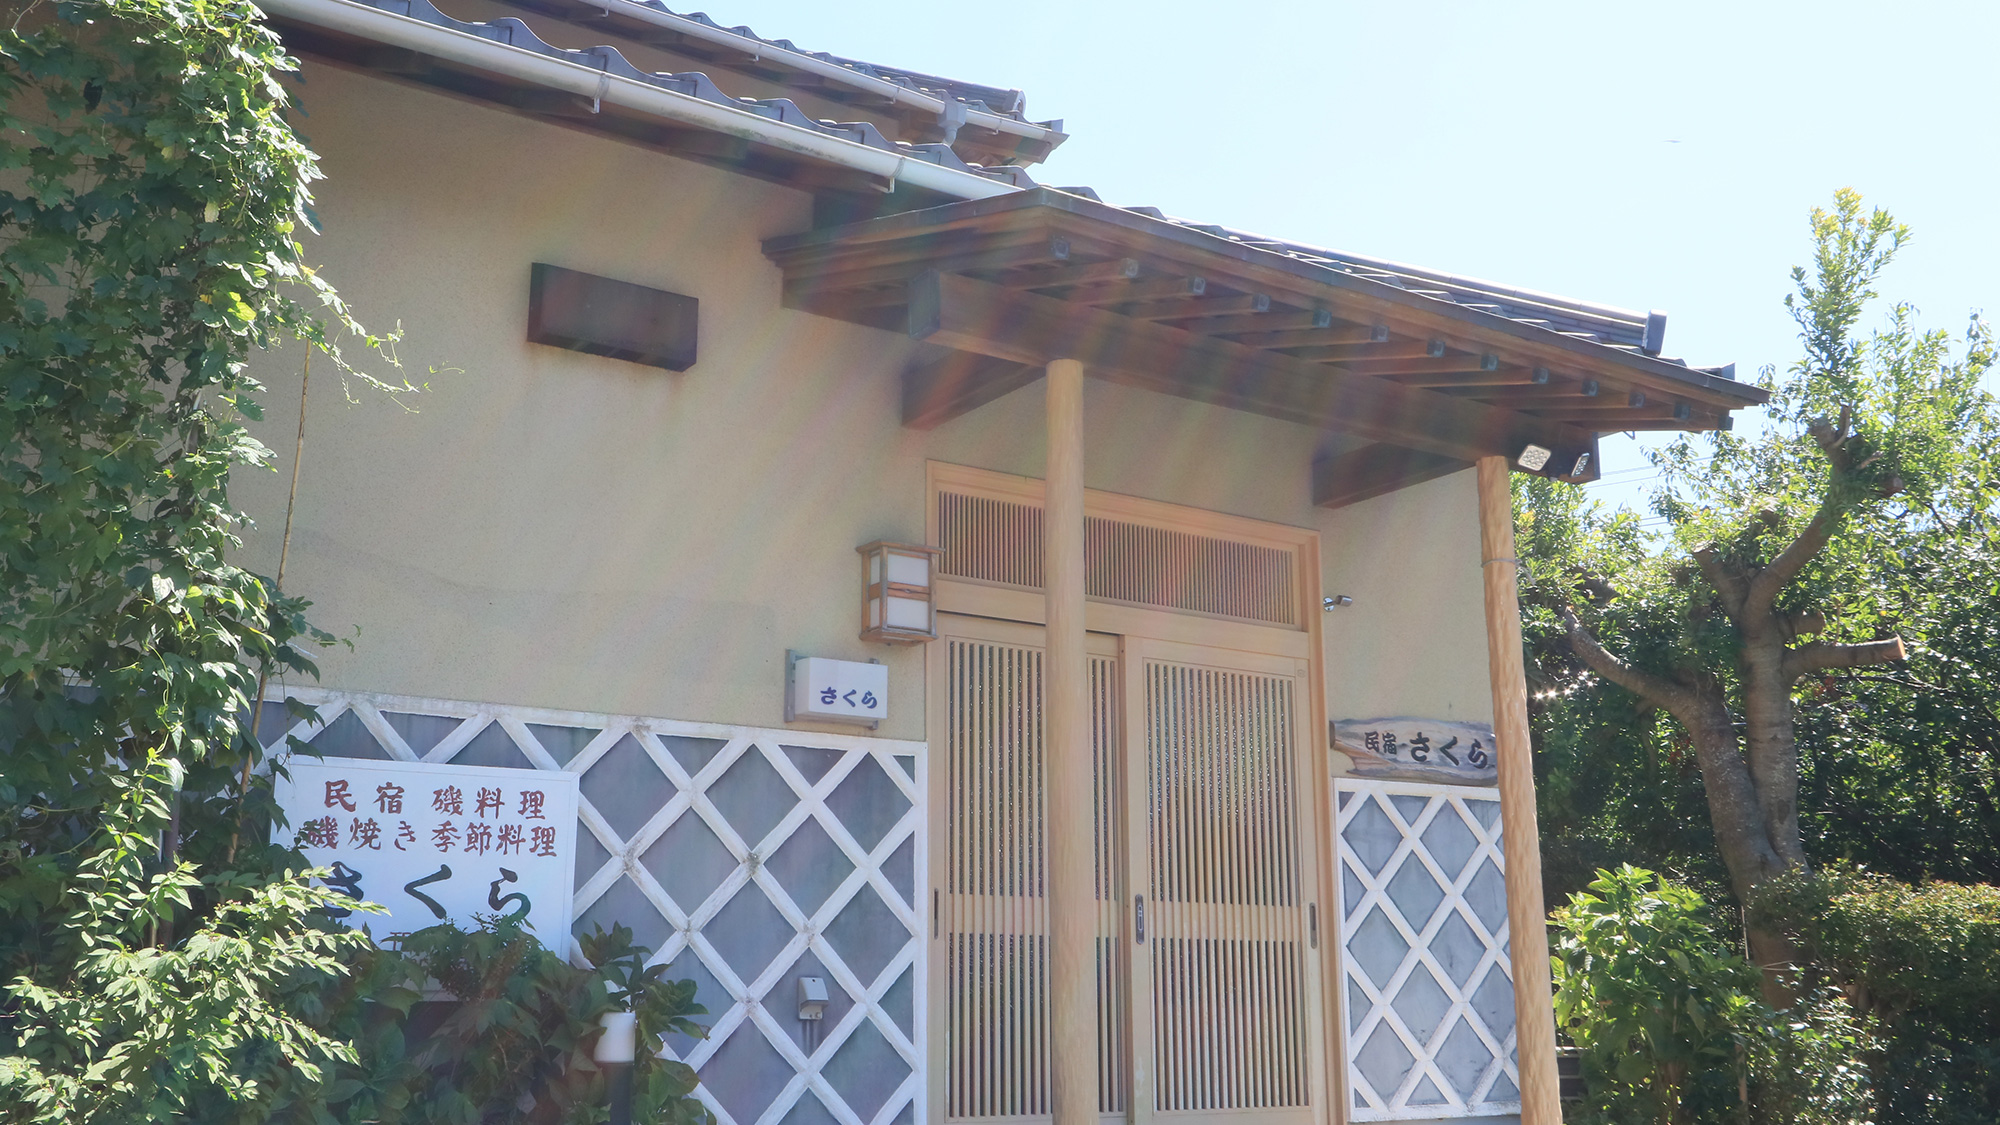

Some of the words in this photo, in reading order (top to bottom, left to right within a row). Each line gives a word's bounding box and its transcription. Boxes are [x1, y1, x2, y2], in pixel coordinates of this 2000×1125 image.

[820, 686, 878, 709] さくら
[1410, 731, 1488, 769] さくら
[324, 779, 405, 814] 民宿
